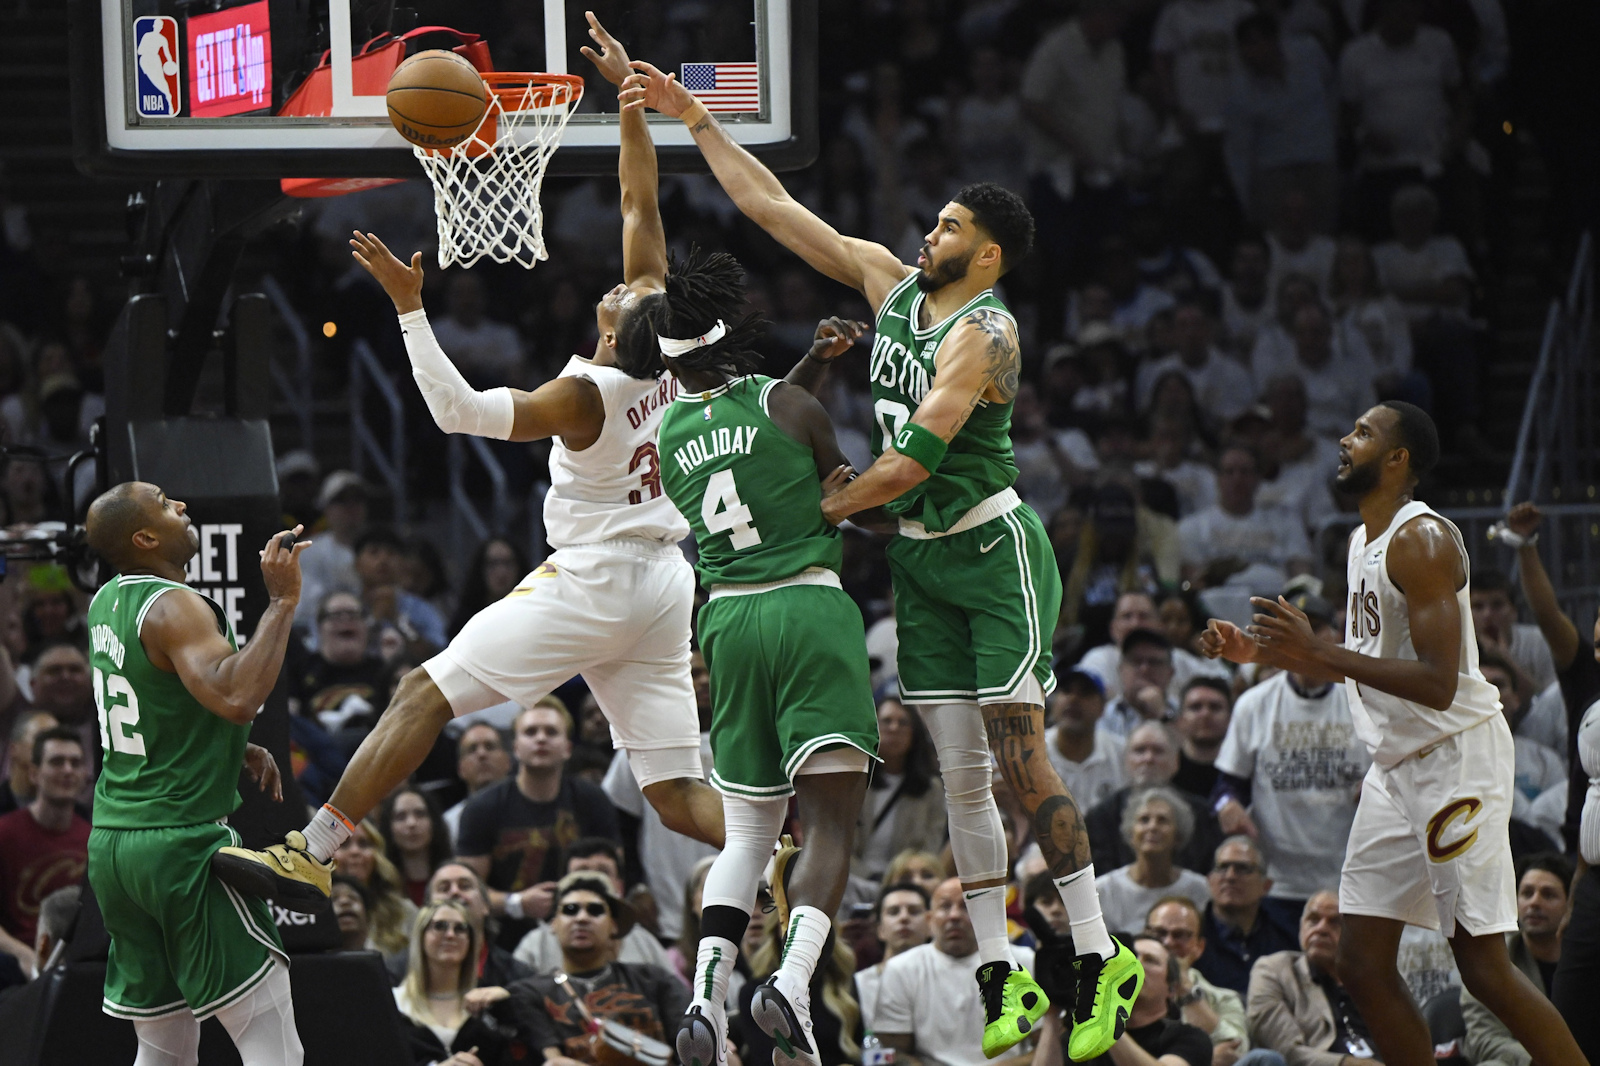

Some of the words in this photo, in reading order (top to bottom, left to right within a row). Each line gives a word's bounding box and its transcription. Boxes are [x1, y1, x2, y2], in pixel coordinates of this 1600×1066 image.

[143, 94, 164, 112] NBA
[401, 122, 466, 145] Wilson
[870, 333, 936, 406] OSTON
[626, 376, 678, 430] OKORO
[874, 398, 911, 453] 0
[673, 425, 759, 476] HOLIDAY
[896, 429, 914, 449] 0
[628, 441, 662, 505] 3
[701, 468, 762, 551] 4
[90, 623, 126, 670] HORFORD
[93, 667, 146, 756] 42
[265, 898, 317, 926] ixe
